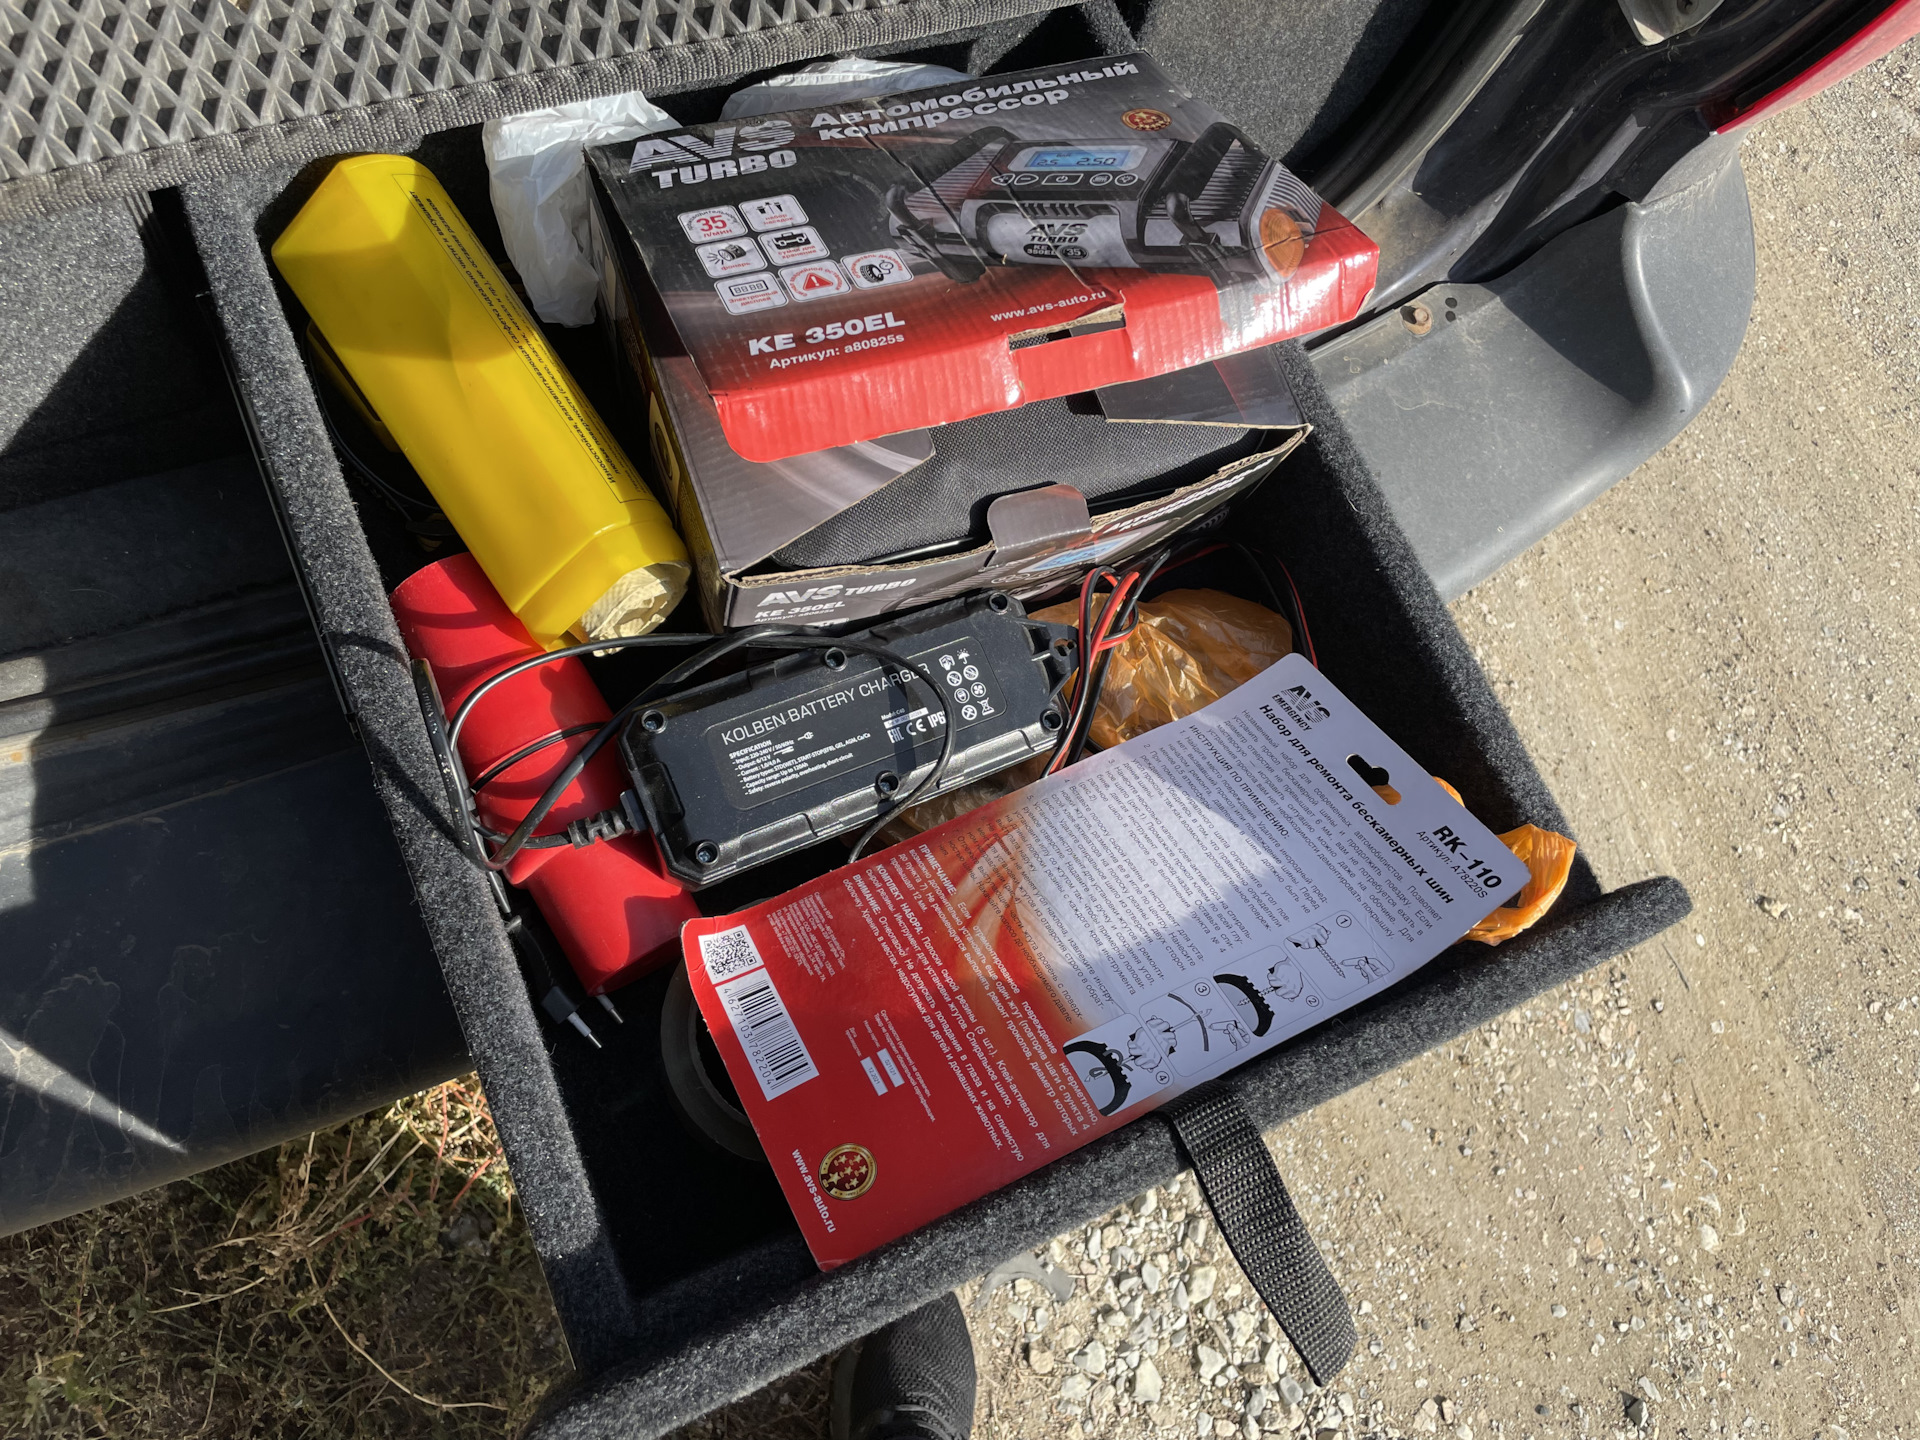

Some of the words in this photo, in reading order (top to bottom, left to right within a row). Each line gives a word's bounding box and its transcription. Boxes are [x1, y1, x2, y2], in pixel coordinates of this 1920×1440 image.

[810, 62, 1139, 128] Автомобильный
[819, 88, 1070, 141] компрессор
[629, 120, 796, 174] AVS
[651, 150, 797, 189] TURBO
[696, 215, 728, 232] 35
[1025, 223, 1088, 236] AVS
[990, 291, 1107, 322] www.avs-auto.ru
[749, 332, 796, 356] KE
[805, 312, 906, 344] 350EL
[769, 347, 840, 369] Артикул:
[844, 333, 905, 354] a80825s
[755, 609, 784, 619] KE
[788, 601, 845, 614] 350EL
[757, 584, 844, 607] AVS
[845, 578, 917, 596] TURBO
[721, 713, 787, 746] KOLBEN
[787, 688, 855, 722] BATTERY
[927, 711, 947, 728] IP6
[1270, 694, 1312, 732] EMERGENCY
[1281, 685, 1331, 724] AVS
[1187, 724, 1232, 771] ИНСТРУКЦИЯ
[1238, 782, 1292, 840] ПРИМЕНЕНИЮ:
[1255, 703, 1295, 738] Набор
[1286, 736, 1312, 757] для
[1306, 757, 1355, 802] ремонта
[1349, 800, 1430, 877] бескамерных
[1423, 875, 1456, 905] шин
[1414, 829, 1454, 865] Артикул:
[1449, 863, 1489, 899] A78220S
[853, 872, 883, 914] ВНИМАНИЕ:
[878, 915, 908, 957] Огнеопасно!
[910, 970, 939, 1009] допускать
[933, 1009, 964, 1053] попадания
[964, 1062, 983, 1087] глаза
[992, 1112, 1026, 1163] слизистую
[875, 862, 904, 901] КОМПЛЕКТ
[900, 902, 925, 934] НАБОРА:
[921, 936, 945, 966] Полоски
[939, 967, 960, 992] сырой
[955, 993, 978, 1023] резины
[980, 1036, 1000, 1059] шт.).
[994, 1059, 1041, 1128] Клей-активатор
[1035, 1129, 1053, 1149] для
[791, 1148, 836, 1233] www.avs-auto.ru
